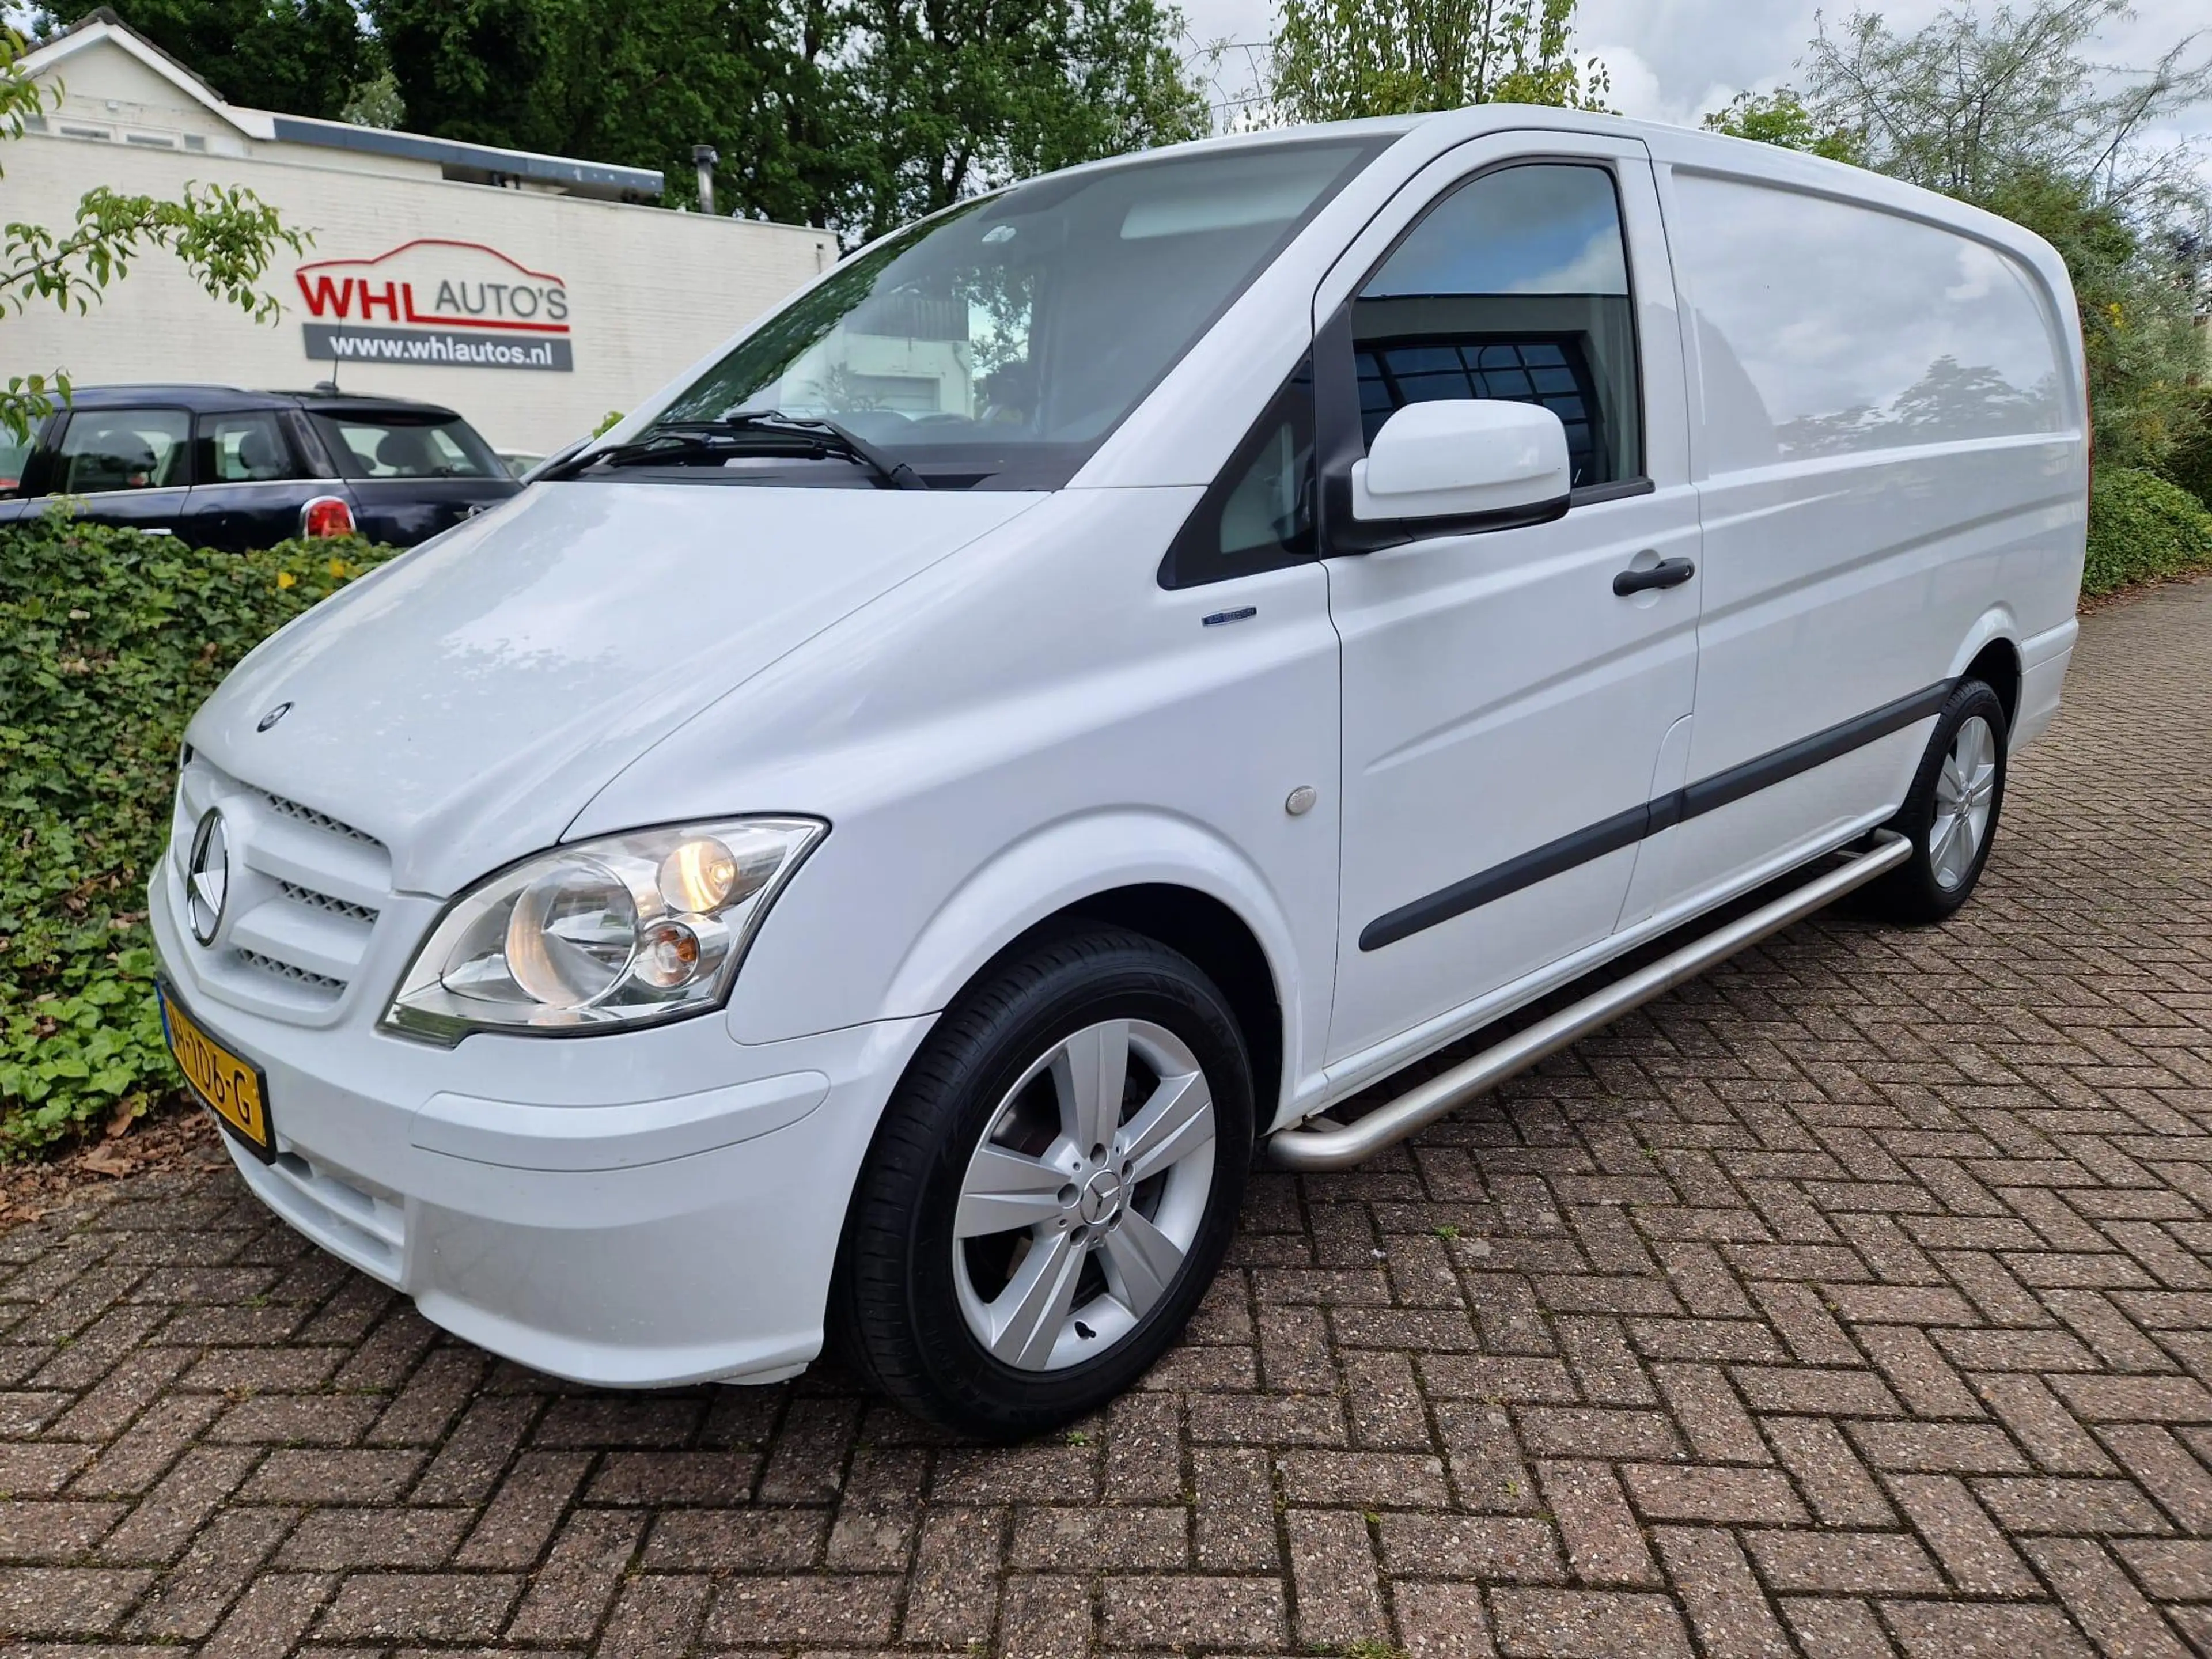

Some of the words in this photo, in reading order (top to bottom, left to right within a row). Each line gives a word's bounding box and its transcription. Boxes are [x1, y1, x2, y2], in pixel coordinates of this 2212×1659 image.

[296, 273, 425, 323] WHL
[435, 279, 568, 320] AUTO'S
[329, 335, 553, 365] www.whlautos.nl
